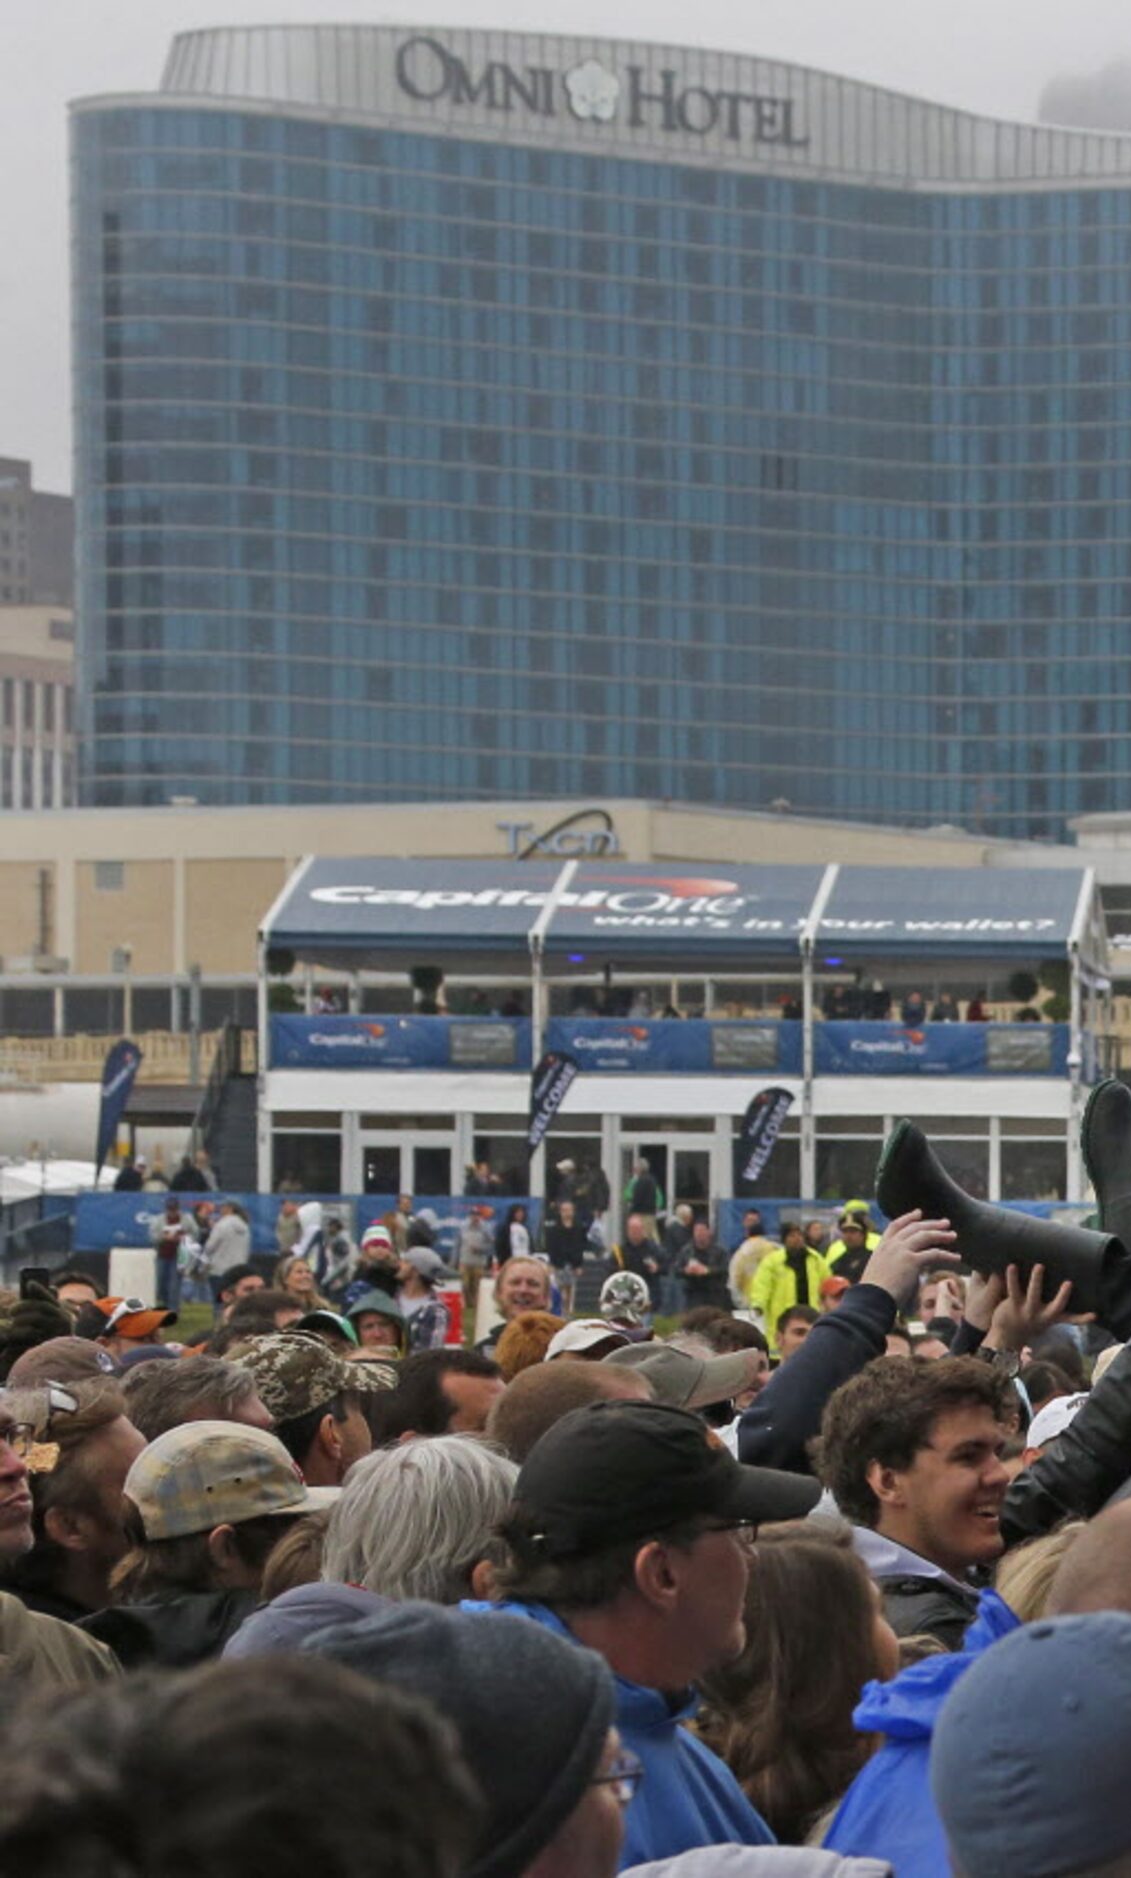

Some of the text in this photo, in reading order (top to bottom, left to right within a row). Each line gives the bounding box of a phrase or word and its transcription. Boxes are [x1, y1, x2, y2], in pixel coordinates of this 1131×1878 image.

[396, 37, 809, 146] OMNI HOTEL
[743, 918, 783, 930] in
[905, 918, 1055, 931] wallet?
[528, 1062, 577, 1146] WELCOME
[742, 1095, 789, 1180] WELCOME
